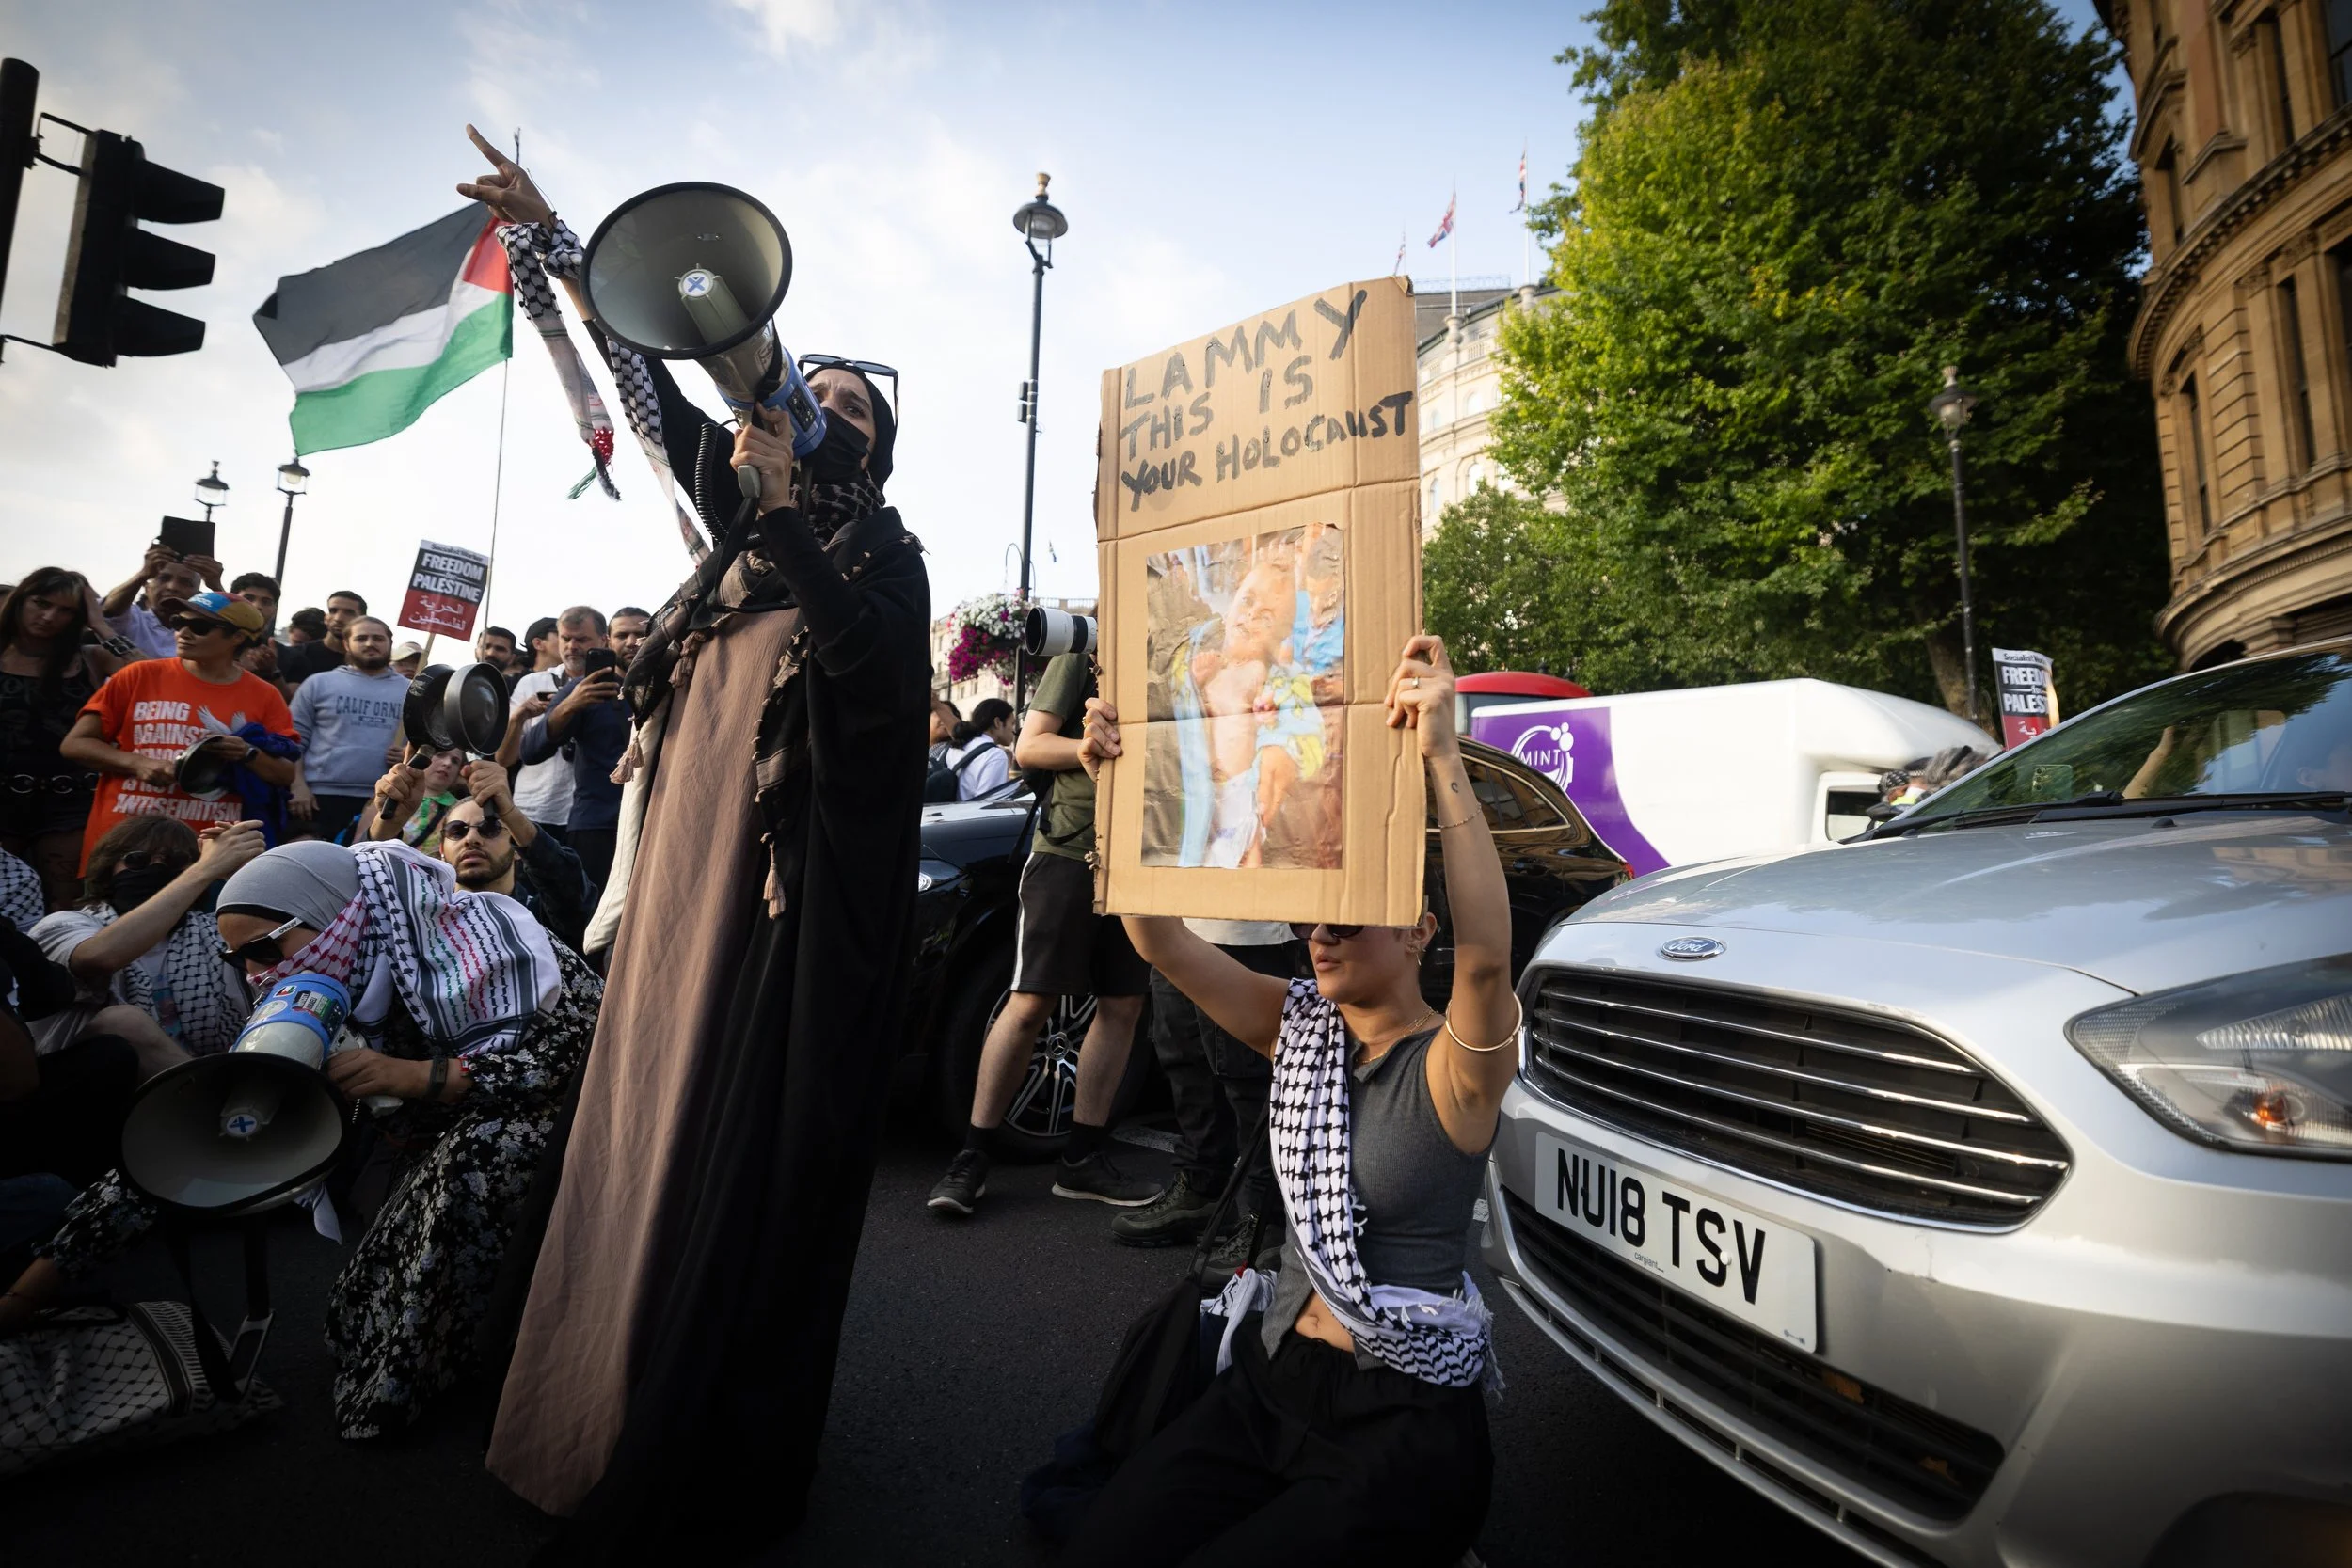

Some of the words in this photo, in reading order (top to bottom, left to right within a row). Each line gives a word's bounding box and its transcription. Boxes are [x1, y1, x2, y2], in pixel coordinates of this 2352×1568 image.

[1124, 289, 1368, 410] LAMMY
[1120, 392, 1215, 462] THIS
[1259, 354, 1314, 414] IS
[1120, 450, 1203, 513] YOUR
[1216, 390, 1413, 483] HOLOCAUST
[421, 552, 485, 581] FREEDOM
[412, 572, 482, 602] PALESTINE
[133, 700, 192, 721] BEING
[1520, 749, 1561, 766] MINT
[112, 793, 243, 821] ANTISEMITISM
[1669, 940, 1709, 952] Ford
[1557, 1148, 1645, 1248] NU18
[1662, 1191, 1766, 1305] TSV
